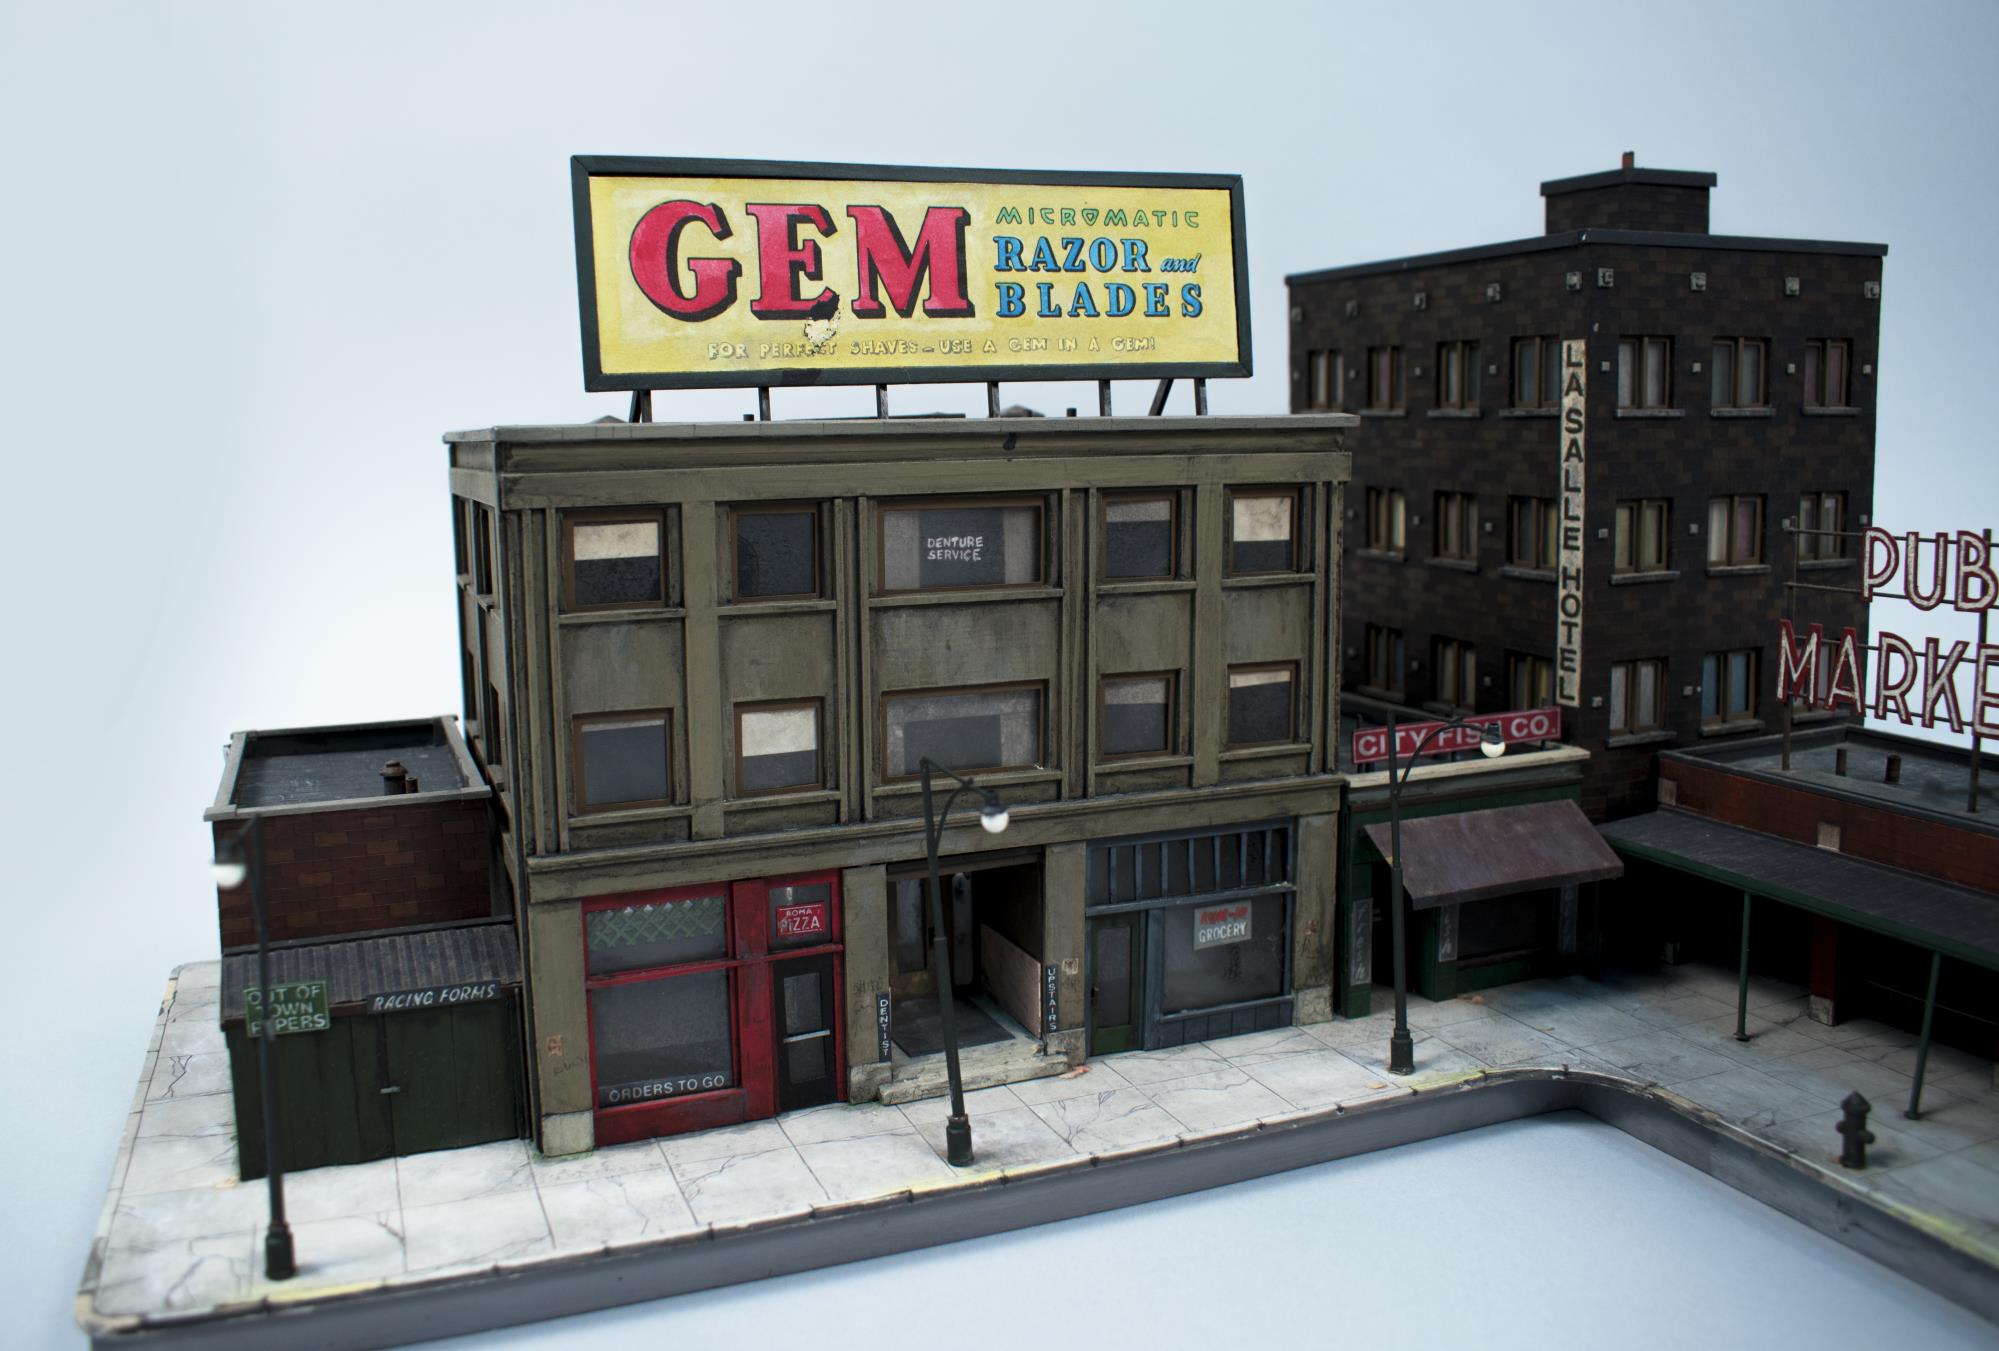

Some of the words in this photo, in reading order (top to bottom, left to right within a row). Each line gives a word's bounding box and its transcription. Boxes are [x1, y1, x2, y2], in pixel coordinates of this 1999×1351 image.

[996, 206, 1200, 228] MICROMATIC
[629, 200, 975, 323] GEM
[993, 236, 1152, 273] RAZOR
[1160, 253, 1202, 273] and
[995, 282, 1203, 318] BLADES
[708, 342, 748, 360] FOR
[983, 340, 997, 353] A
[1008, 338, 1048, 352] GEM
[1057, 337, 1077, 351] IN
[1088, 337, 1100, 351] A
[1111, 336, 1156, 352] GEM!
[928, 536, 984, 548] DENTURE
[928, 549, 982, 561] SERVICE
[1862, 527, 1999, 613] PUB
[1560, 567, 1582, 702] HOTEL
[1358, 728, 1428, 757] CITY
[1510, 714, 1556, 738] CO.
[780, 915, 820, 932] PIZZA
[1199, 921, 1248, 943] GROCERY
[295, 985, 321, 1000] OF
[373, 991, 434, 1010] RACING
[440, 984, 496, 1002] FORMS
[1047, 968, 1057, 1030] UPSTAIRS
[880, 999, 889, 1056] DENTIST
[609, 1082, 673, 1102] ORDERS
[678, 1079, 698, 1091] TO
[702, 1075, 725, 1088] GO
